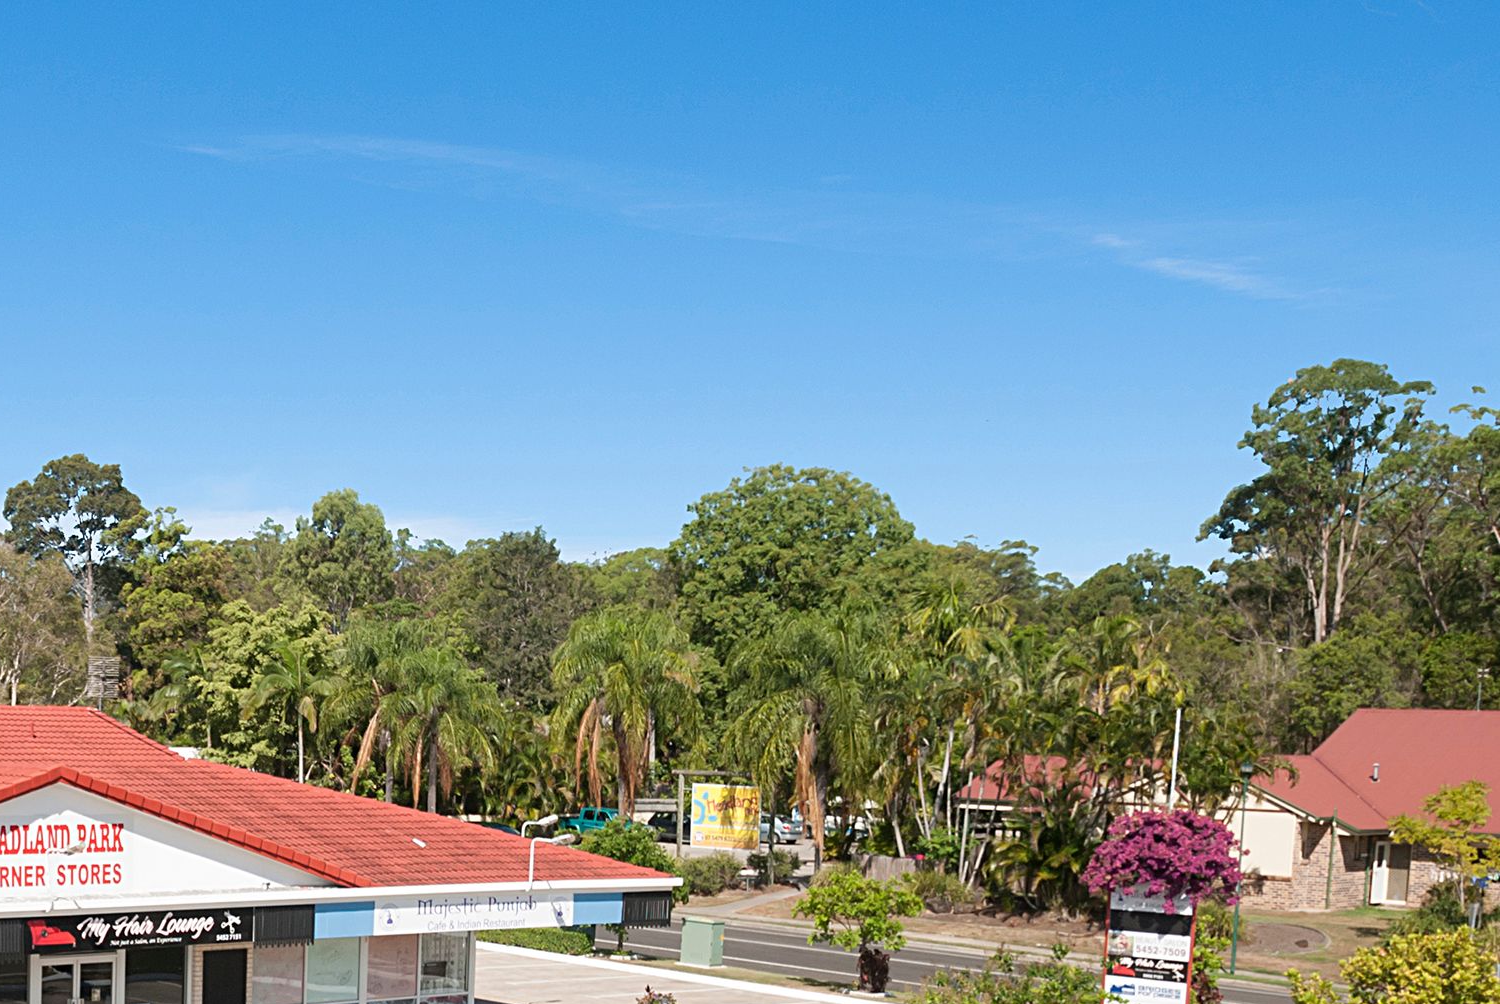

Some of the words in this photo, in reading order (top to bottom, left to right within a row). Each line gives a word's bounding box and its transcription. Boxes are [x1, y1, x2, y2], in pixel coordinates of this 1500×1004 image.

[77, 823, 124, 853] PARK
[57, 863, 122, 886] STORES
[418, 898, 481, 918] Majestic
[77, 917, 110, 945] My
[112, 914, 154, 937] Hair
[156, 912, 215, 940] Lounge
[427, 919, 447, 931] Cafe
[450, 920, 455, 929] &
[457, 919, 482, 929] Indian
[483, 918, 526, 928] Restaurant
[1136, 945, 1186, 957] 5452-7509
